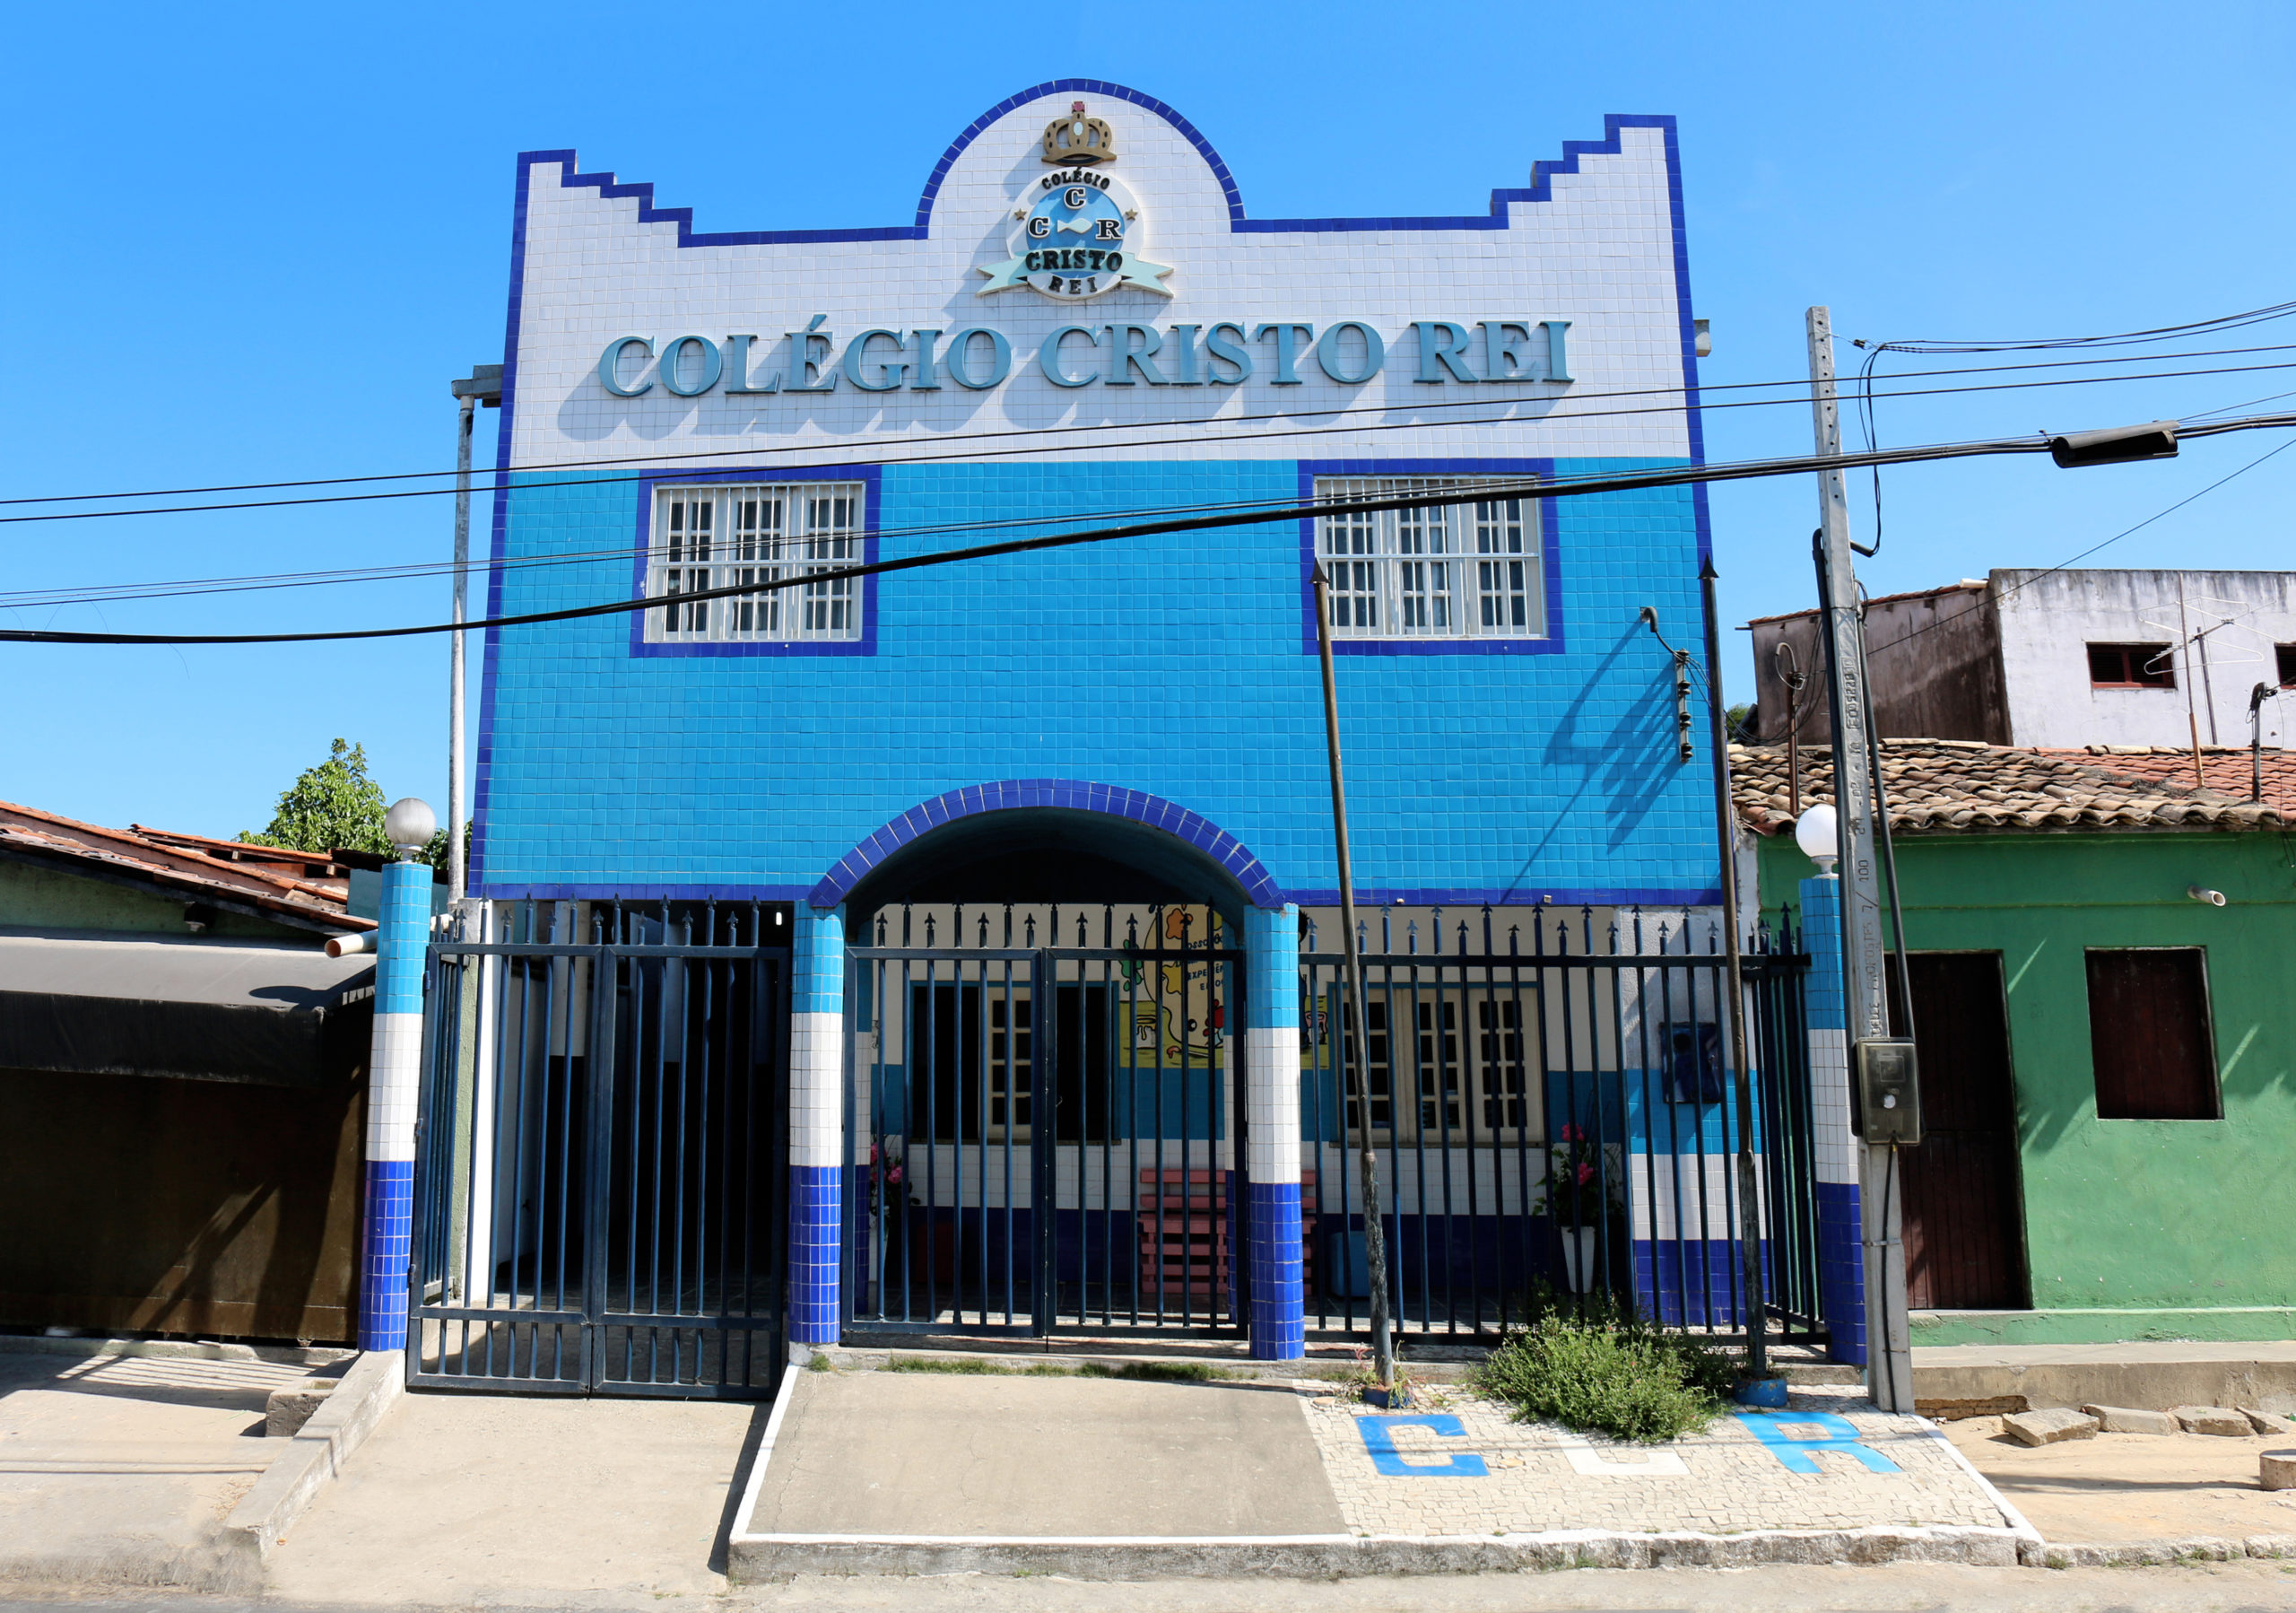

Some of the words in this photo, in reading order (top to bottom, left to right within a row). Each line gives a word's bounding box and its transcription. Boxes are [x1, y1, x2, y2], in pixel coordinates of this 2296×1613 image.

[1041, 167, 1110, 190] COLÉGIO
[1065, 188, 1085, 207] C
[1029, 217, 1049, 236] C
[1096, 219, 1122, 239] R
[1025, 249, 1123, 271] CRISTO
[1048, 275, 1098, 294] REI
[598, 314, 1013, 397] COLÉGIO
[1039, 321, 1385, 388] CRISTO
[1410, 320, 1575, 383] REI
